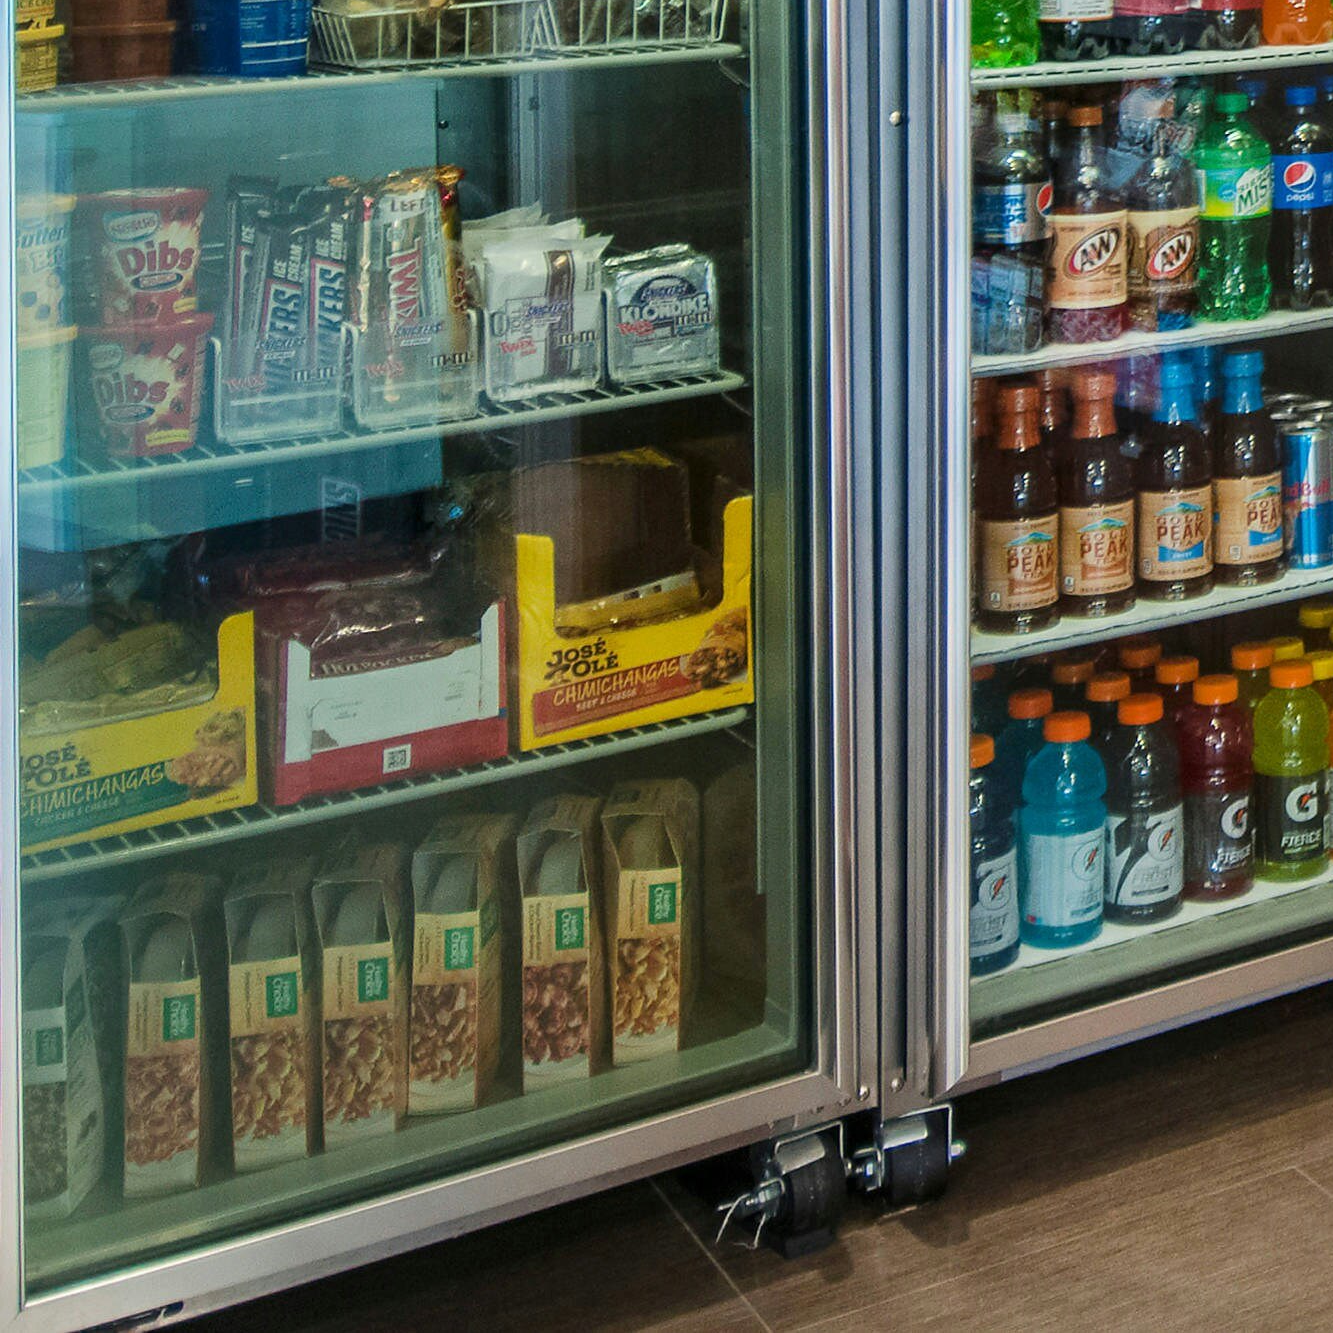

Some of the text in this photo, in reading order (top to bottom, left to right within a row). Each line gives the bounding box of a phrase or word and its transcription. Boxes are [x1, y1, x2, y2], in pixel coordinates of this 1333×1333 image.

[1286, 191, 1315, 205] pepsi
[117, 241, 195, 275] Dibs
[96, 372, 169, 404] Dibs
[1157, 524, 1205, 543] PEAK
[1080, 538, 1129, 561] PEAK
[552, 656, 679, 707] CHIMICHANGAS
[1281, 830, 1324, 849] FIERCE
